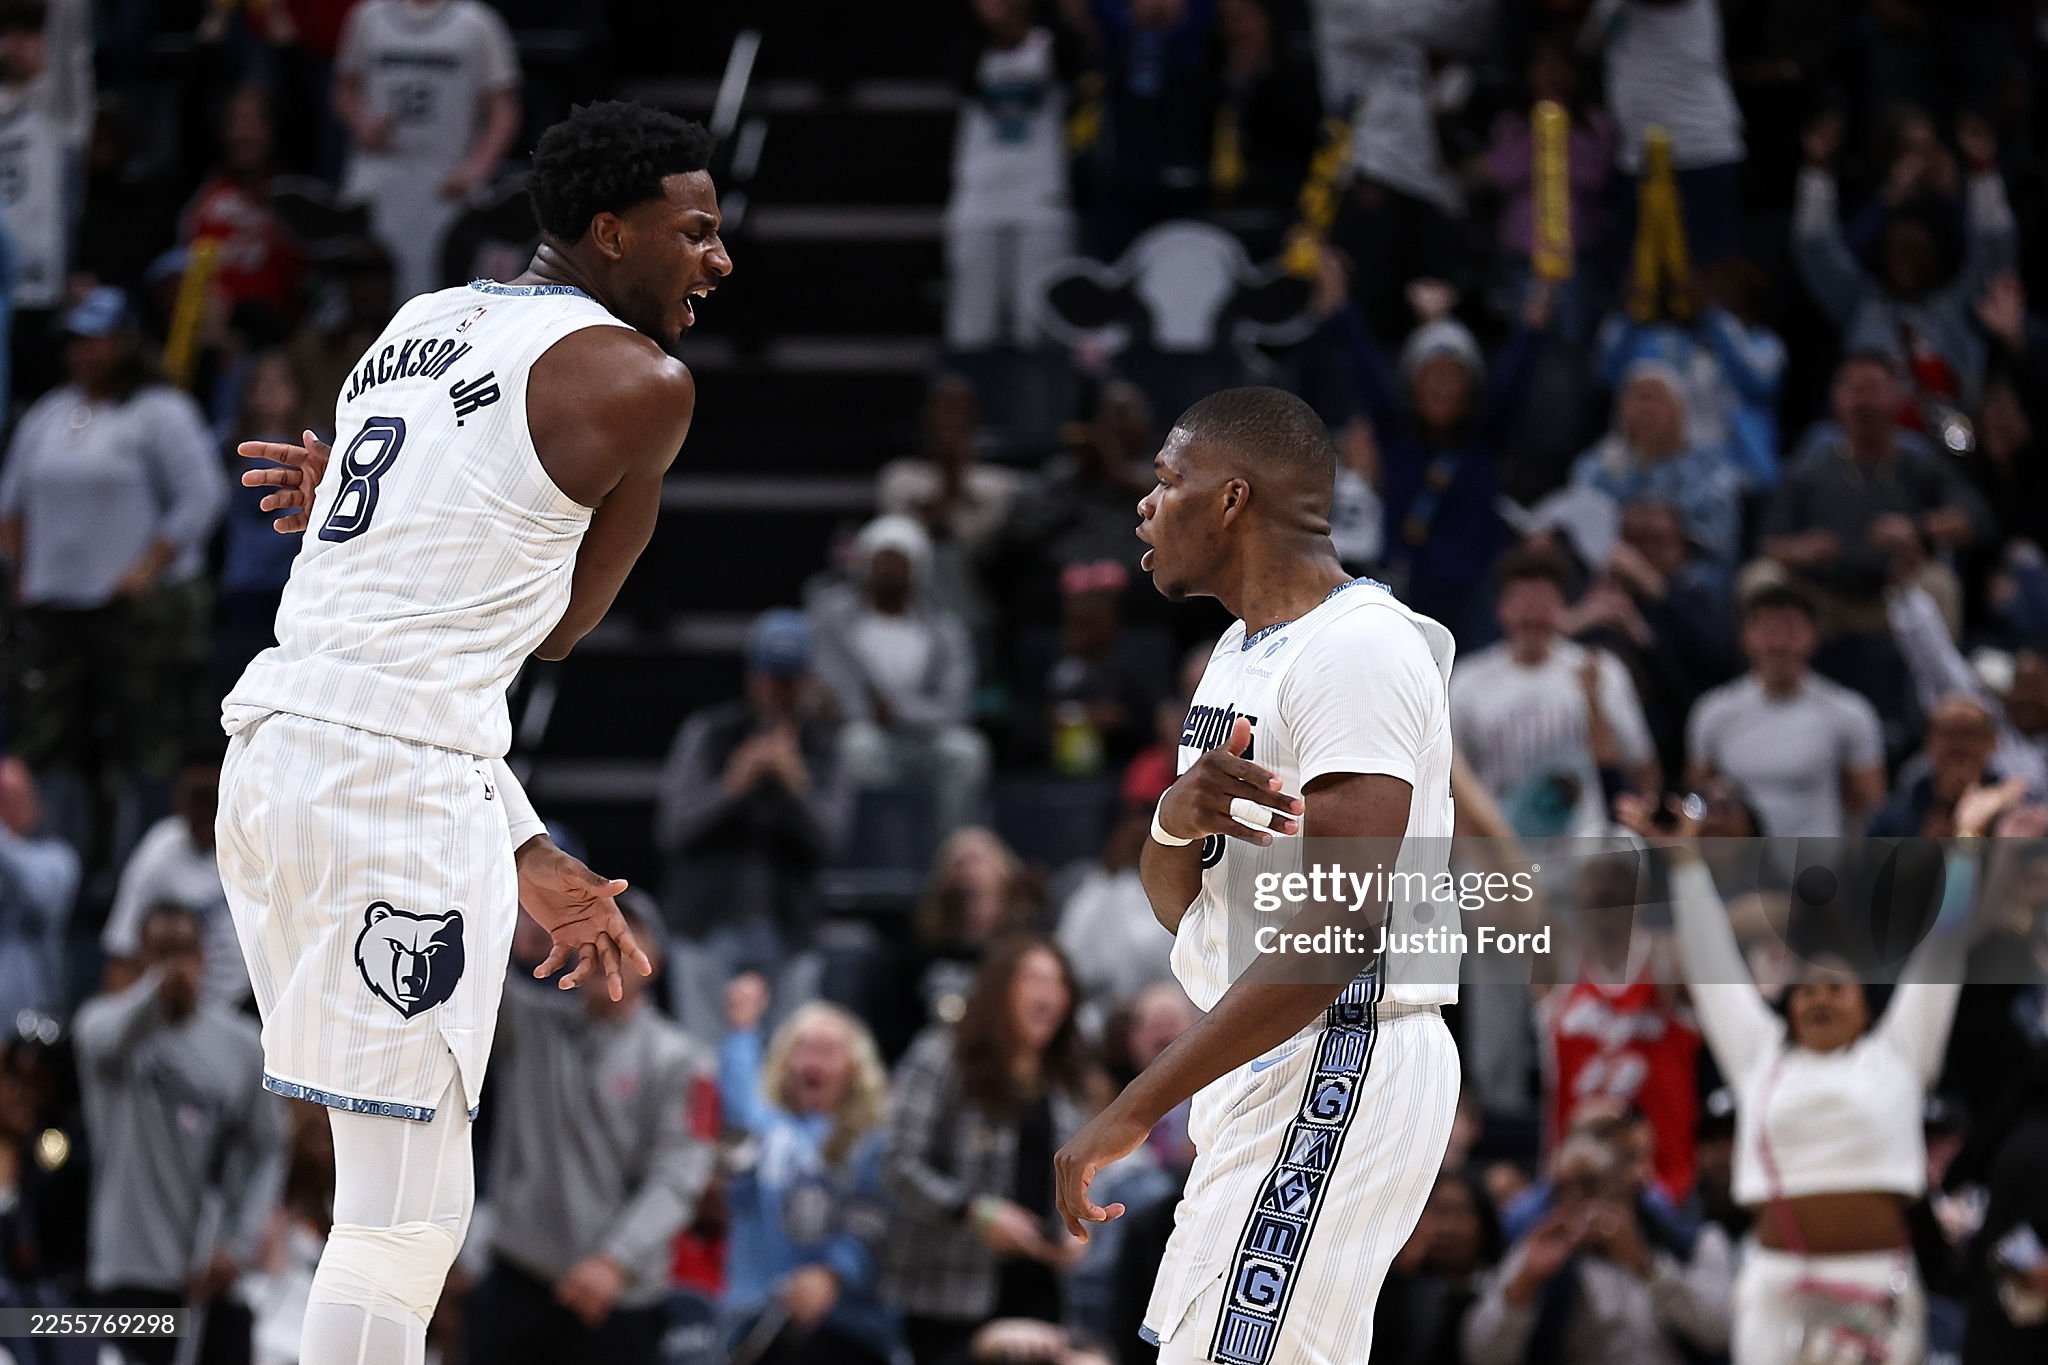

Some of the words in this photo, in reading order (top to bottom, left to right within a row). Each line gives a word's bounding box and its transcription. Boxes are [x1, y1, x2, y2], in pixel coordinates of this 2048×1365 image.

[346, 338, 474, 404] JACKSON
[449, 370, 501, 428] JR.
[317, 415, 407, 544] 8
